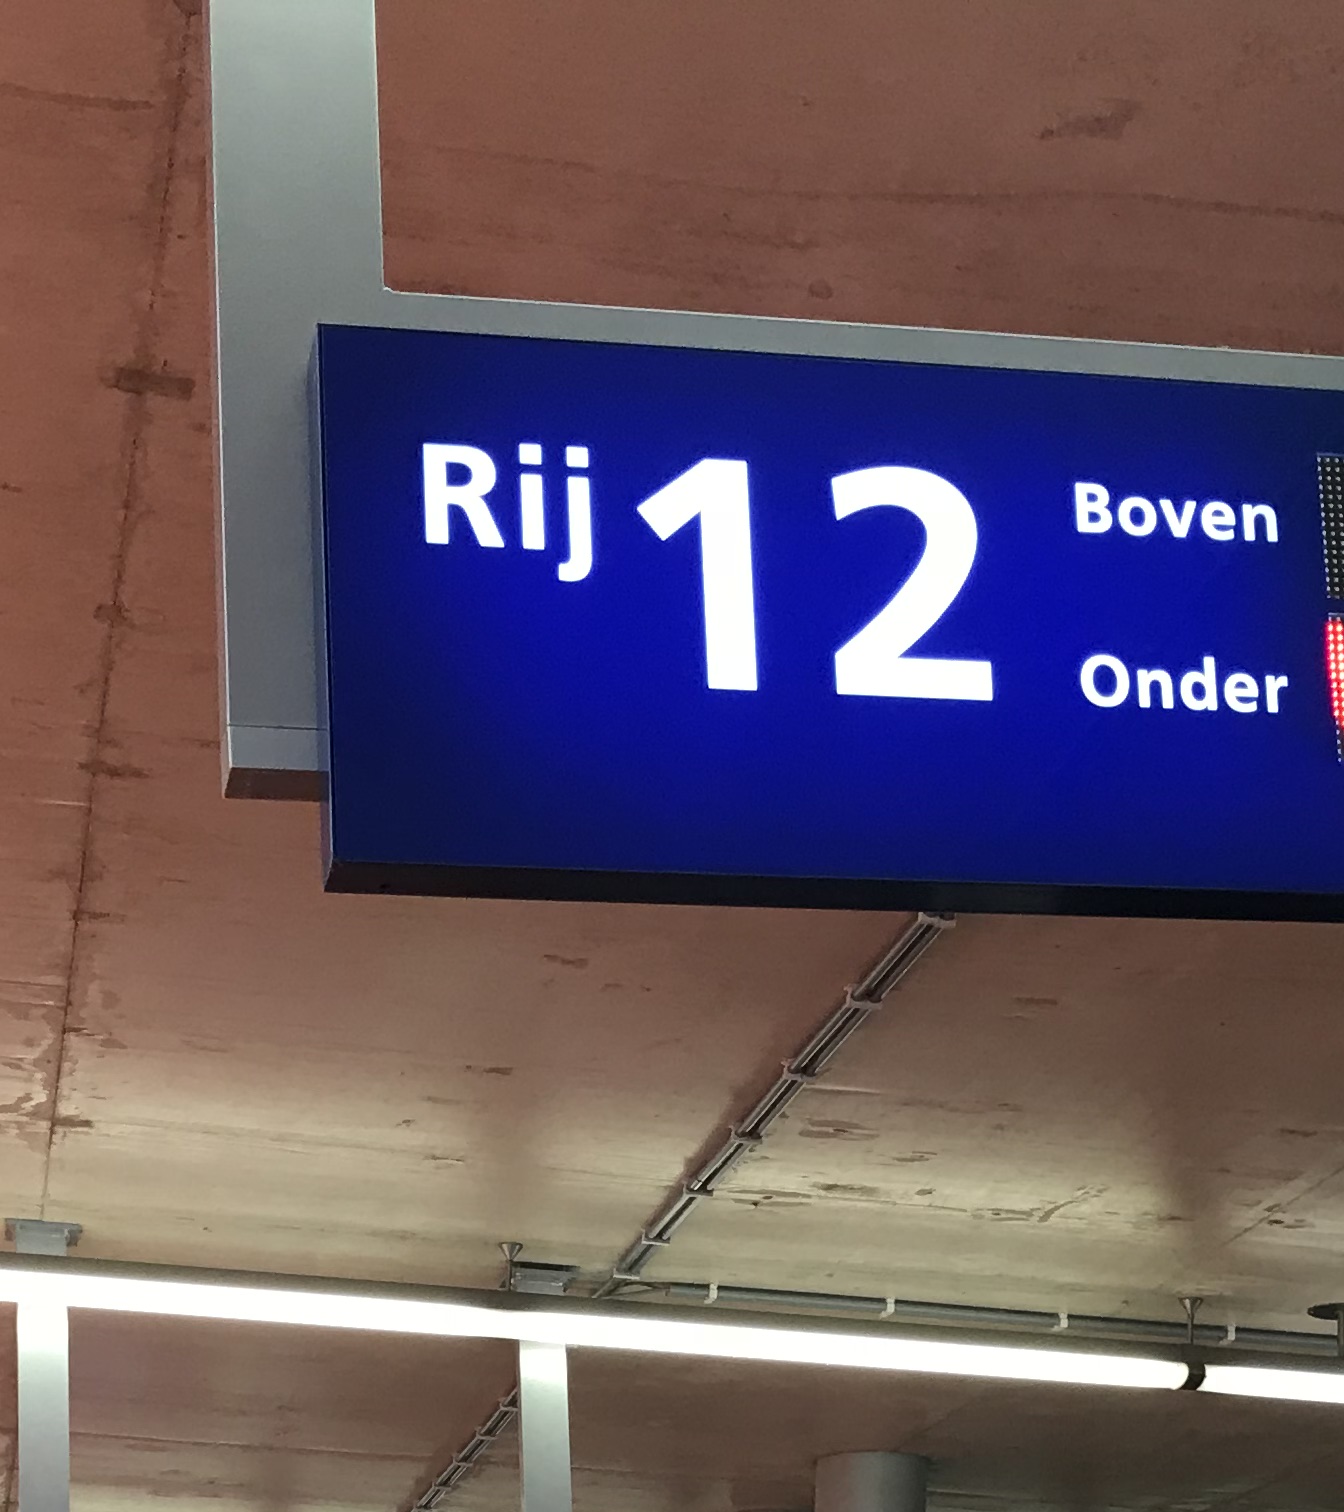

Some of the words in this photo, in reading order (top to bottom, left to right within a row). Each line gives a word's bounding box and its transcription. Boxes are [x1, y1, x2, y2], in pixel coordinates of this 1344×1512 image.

[1073, 482, 1279, 543] Boven
[422, 442, 594, 582] Rij
[637, 458, 994, 701] 12
[1080, 654, 1290, 714] Onder
